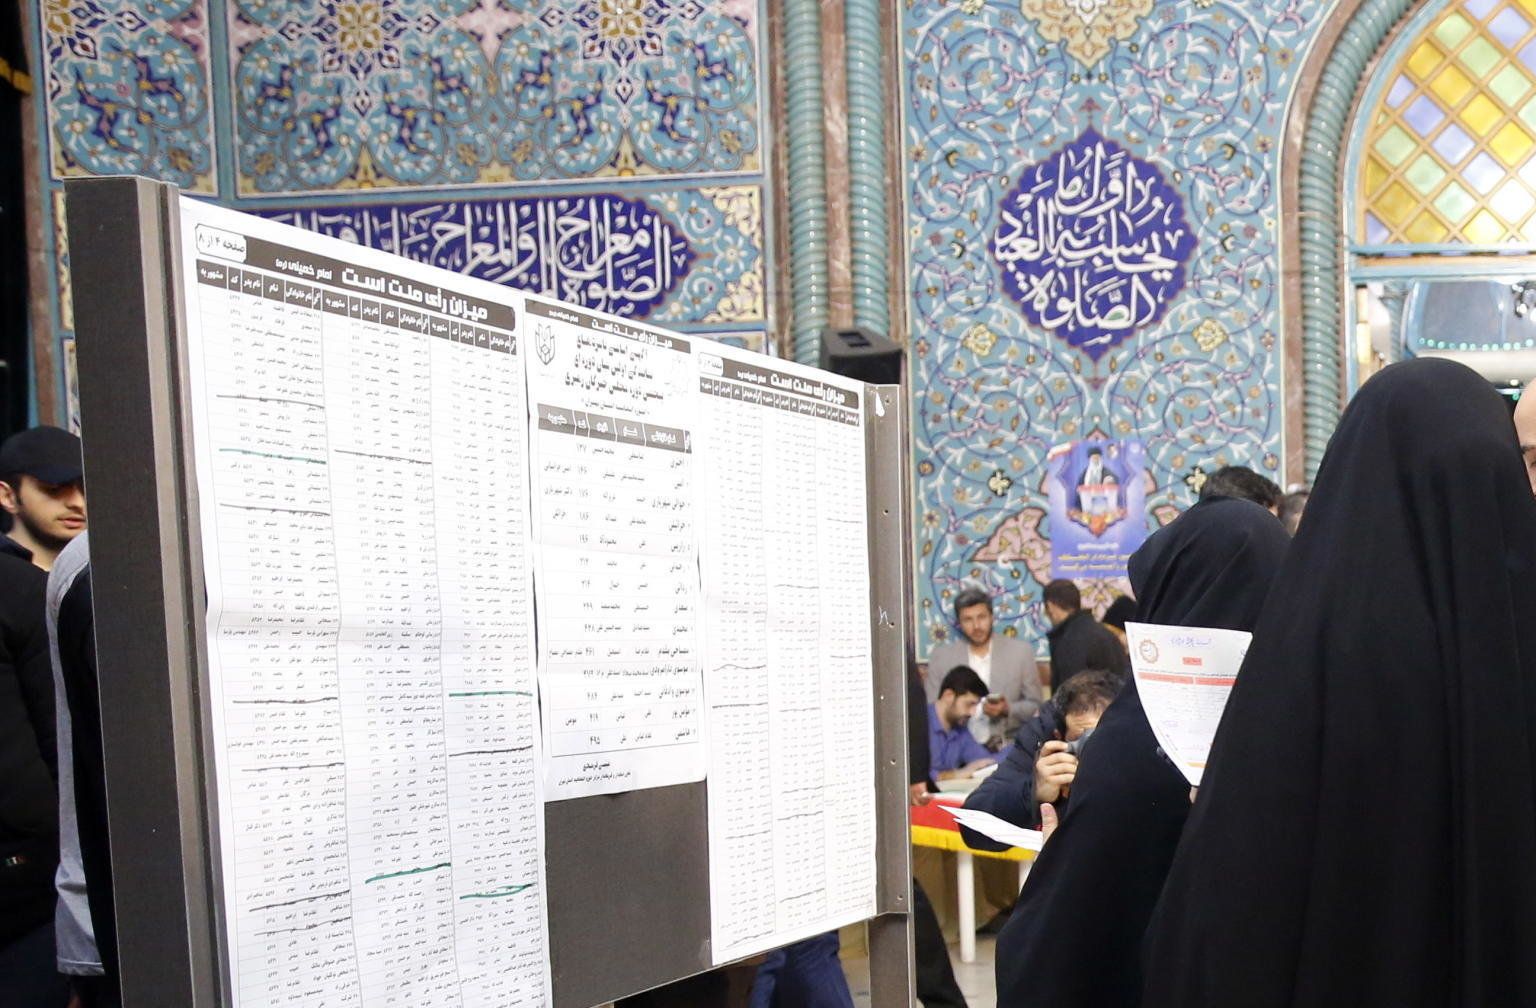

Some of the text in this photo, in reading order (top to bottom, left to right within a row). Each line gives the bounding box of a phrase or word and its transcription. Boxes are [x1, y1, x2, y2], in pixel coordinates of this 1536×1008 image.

[341, 267, 386, 293] است
[388, 279, 423, 303] ملت
[449, 295, 489, 322] میزان
